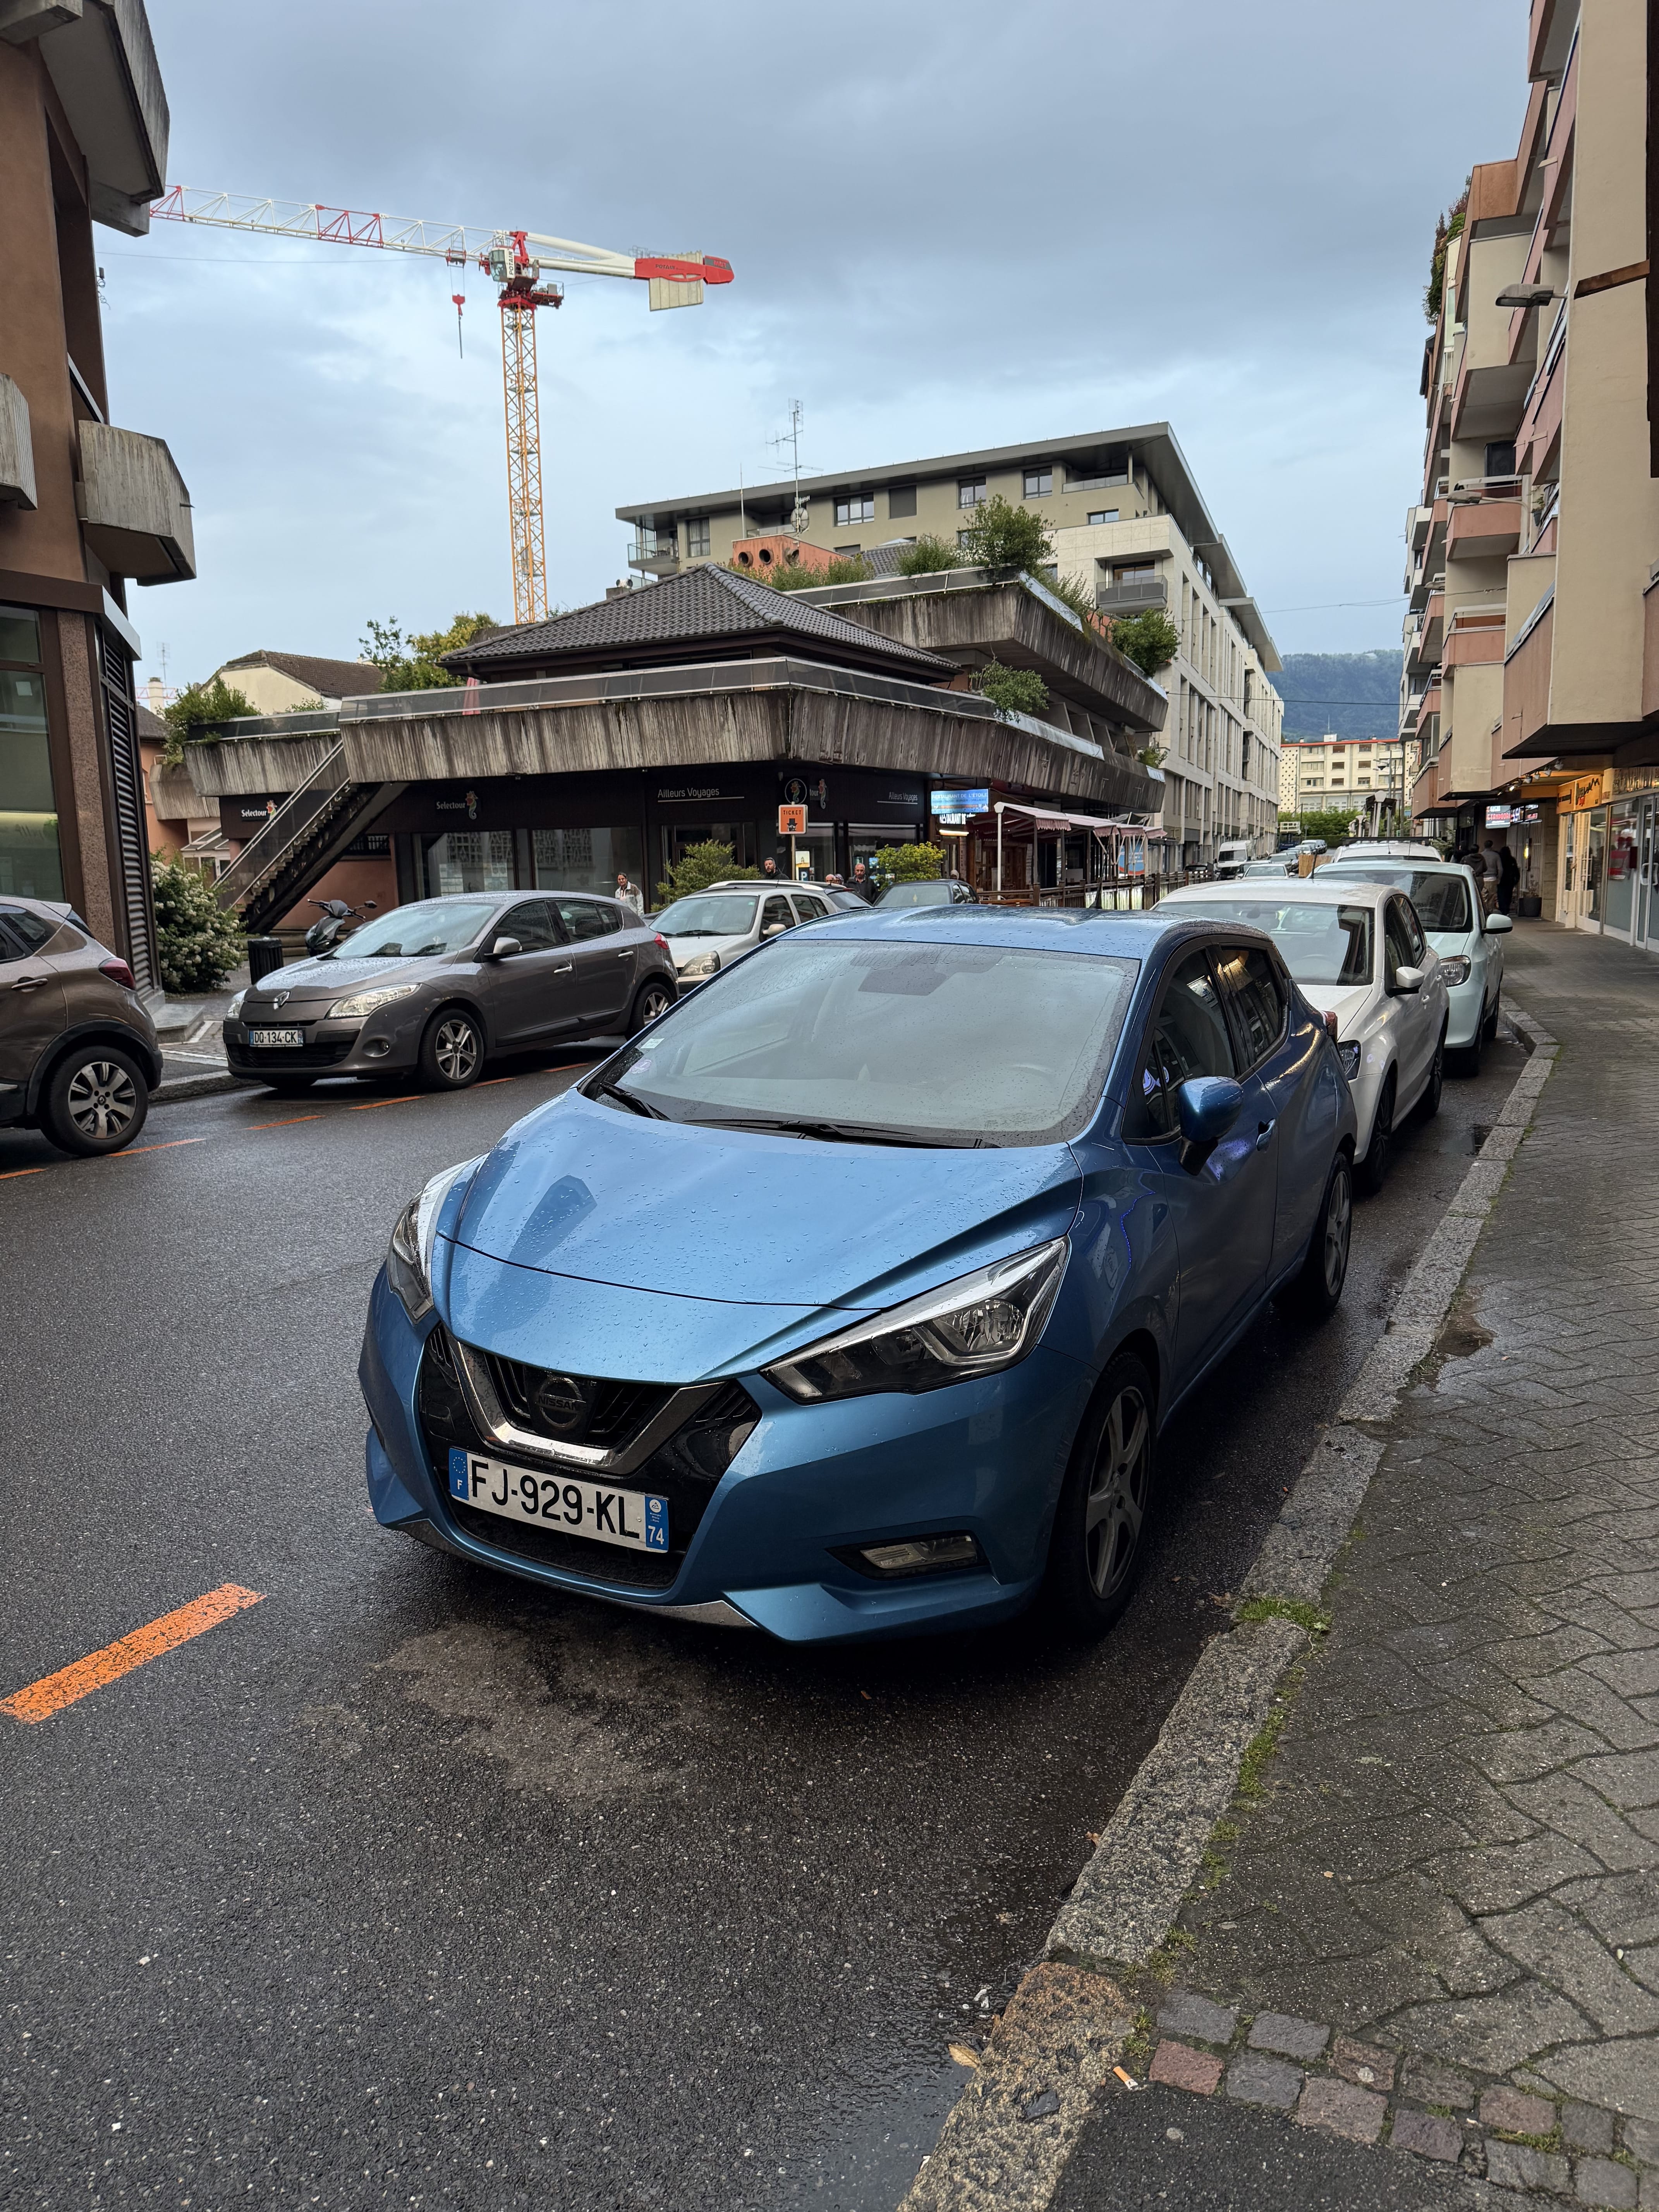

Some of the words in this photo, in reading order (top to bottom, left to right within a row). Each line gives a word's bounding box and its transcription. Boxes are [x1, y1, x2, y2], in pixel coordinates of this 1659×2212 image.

[658, 789, 685, 798] Ailleurs
[687, 787, 720, 798] Voyages
[436, 801, 466, 810] Selectour
[241, 809, 267, 817] Selectour
[254, 1031, 297, 1043] DQ-134-CK
[538, 1395, 580, 1411] NISSAN
[457, 1479, 462, 1490] F
[471, 1460, 640, 1539] FJ-929-KL
[648, 1525, 664, 1545] 74
